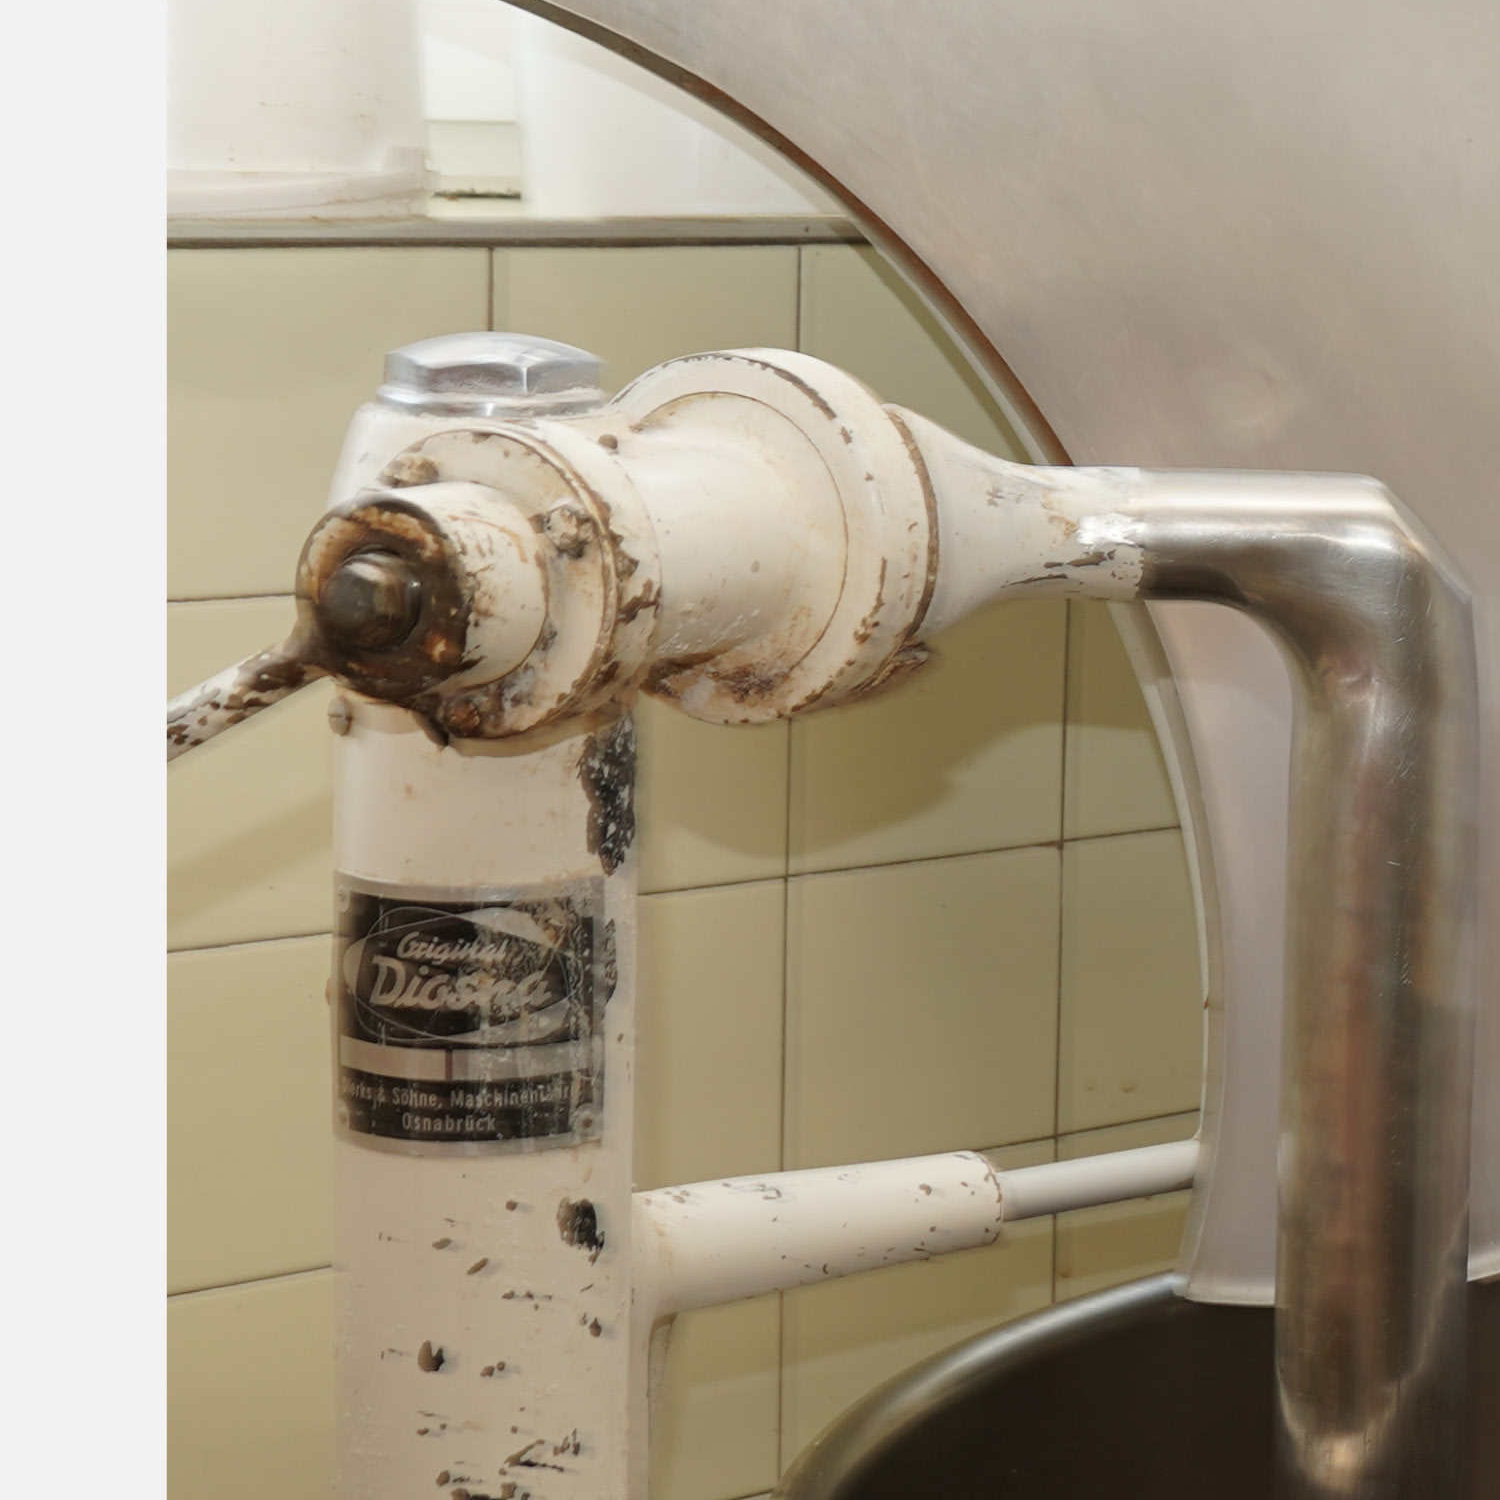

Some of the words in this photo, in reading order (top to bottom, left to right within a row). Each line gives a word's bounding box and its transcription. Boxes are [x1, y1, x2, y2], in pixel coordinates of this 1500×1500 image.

[396, 932, 506, 964] Original
[391, 1086, 443, 1108] Söhne,
[402, 1113, 497, 1133] Osnabrück
